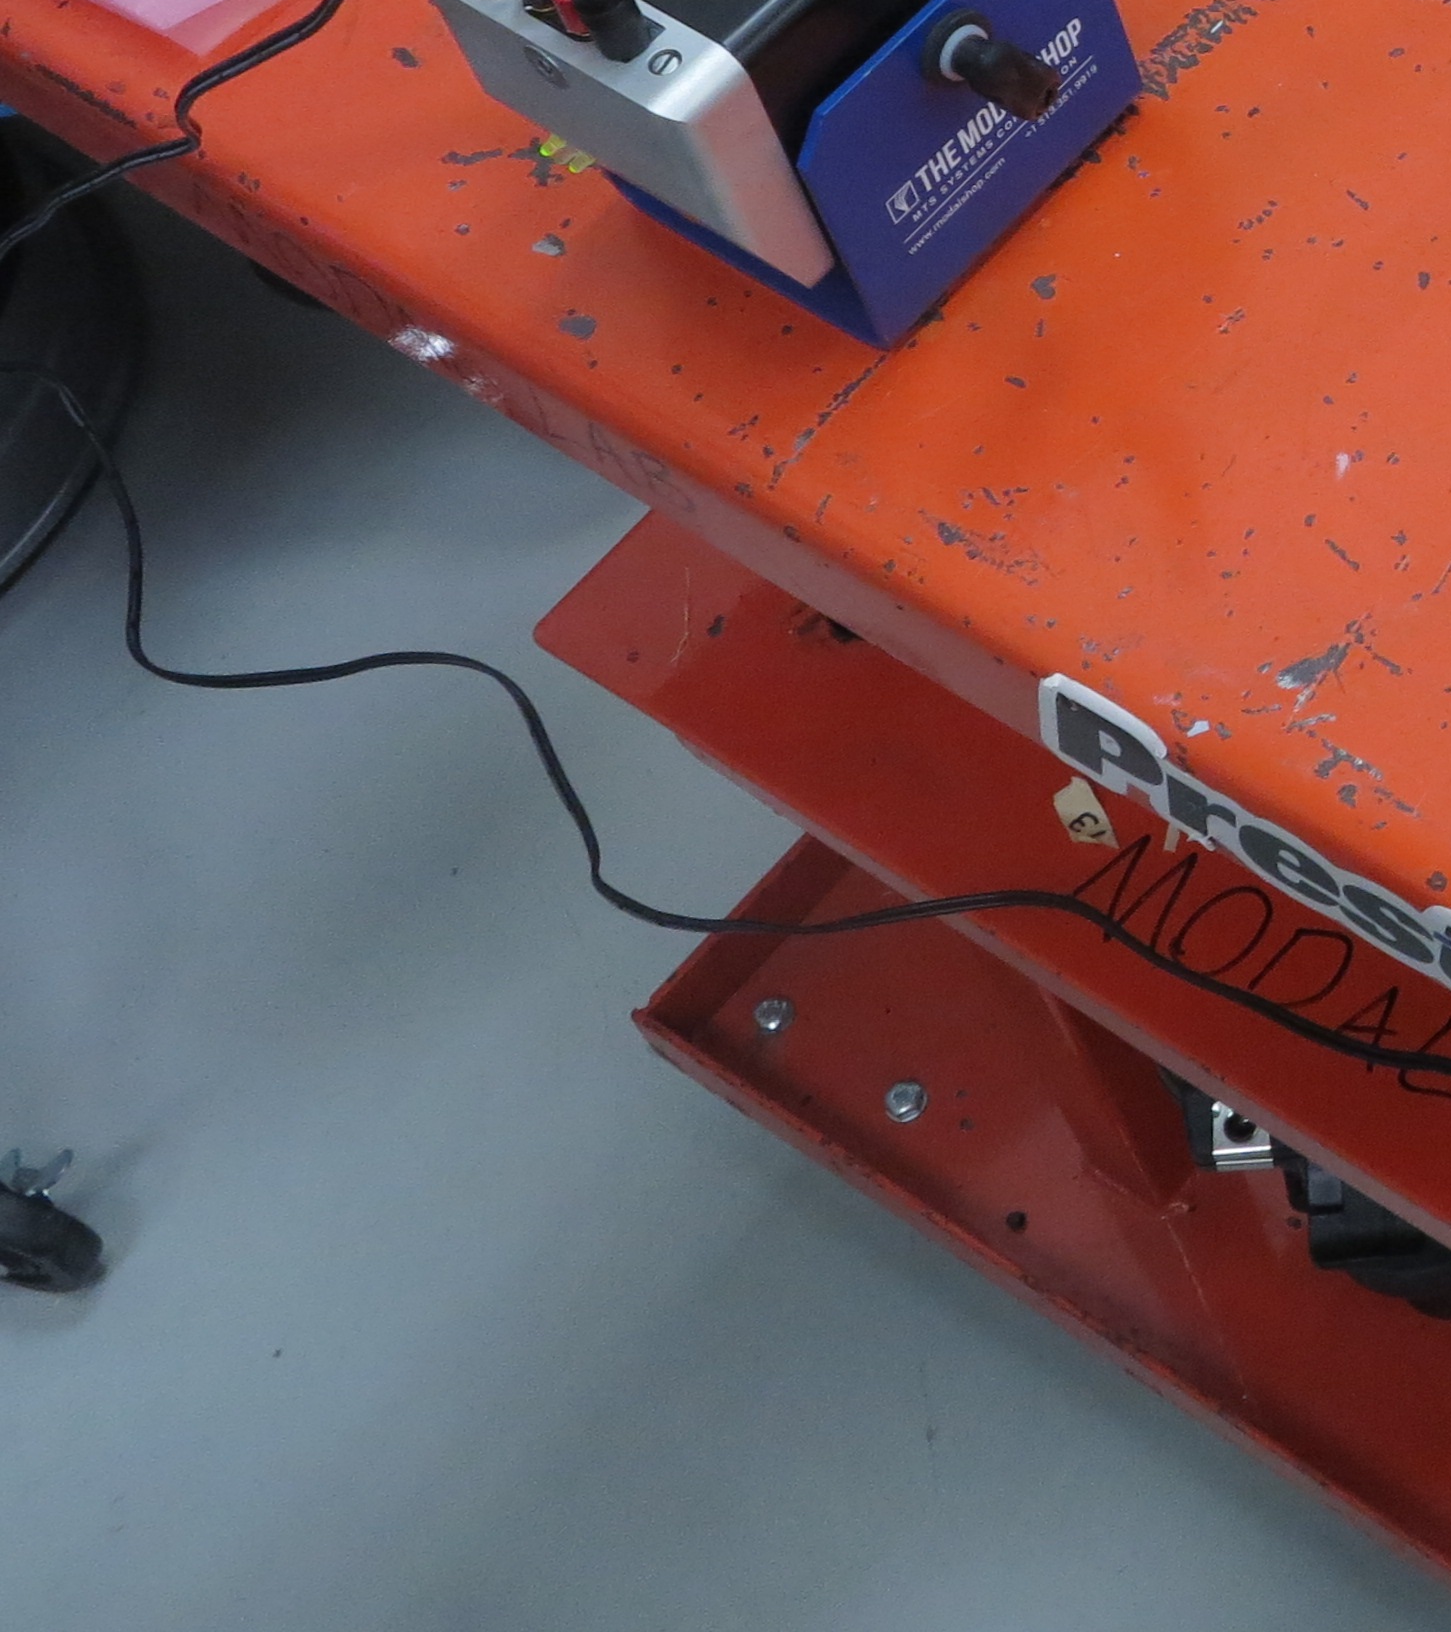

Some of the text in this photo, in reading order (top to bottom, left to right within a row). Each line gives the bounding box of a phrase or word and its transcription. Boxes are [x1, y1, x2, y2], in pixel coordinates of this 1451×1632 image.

[908, 156, 1006, 257] www.modalshop.com
[912, 139, 994, 223] MTS SYSTEMS
[913, 138, 962, 193] THE
